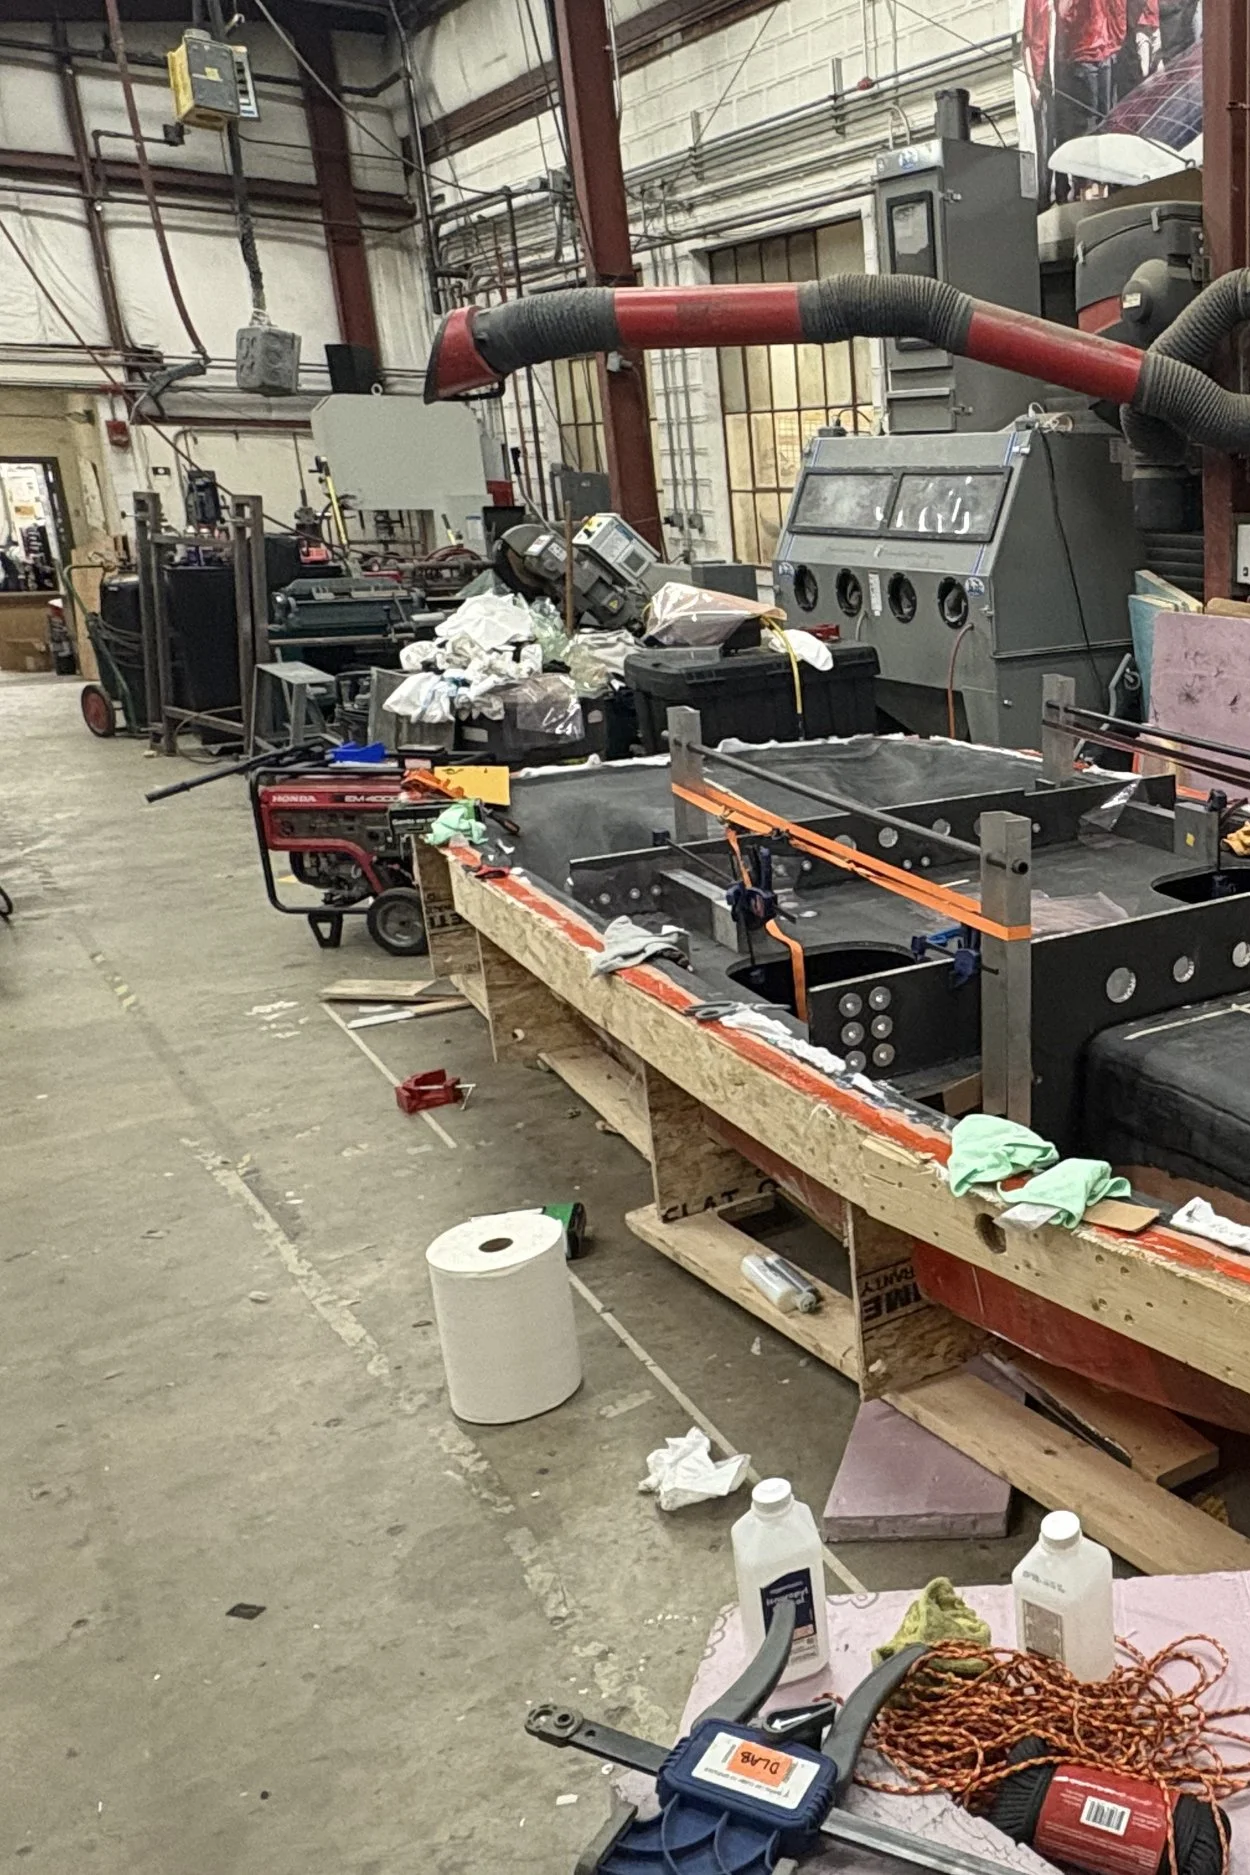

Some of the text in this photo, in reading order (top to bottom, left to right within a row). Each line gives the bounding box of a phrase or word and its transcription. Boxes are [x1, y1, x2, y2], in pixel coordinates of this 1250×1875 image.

[272, 795, 317, 803] HONDA
[860, 1265, 914, 1297] RANTY
[862, 1281, 921, 1322] IME
[741, 1751, 781, 1774] DLAB
